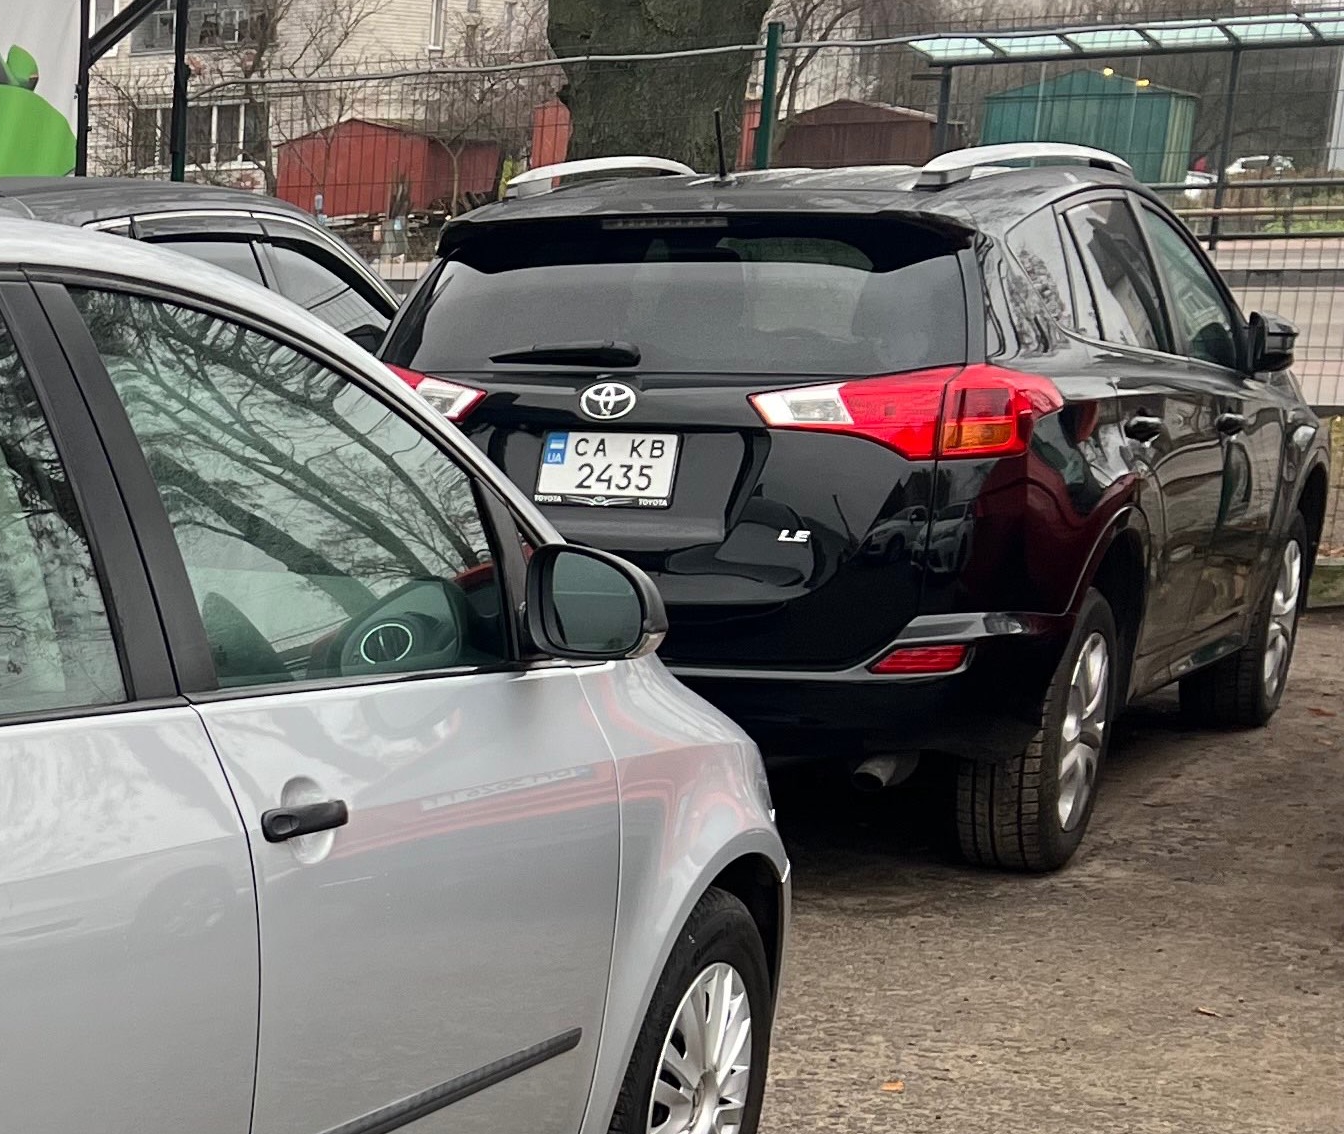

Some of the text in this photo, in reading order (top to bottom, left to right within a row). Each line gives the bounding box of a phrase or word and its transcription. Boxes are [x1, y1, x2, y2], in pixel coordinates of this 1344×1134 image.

[575, 438, 666, 459] CA KB
[547, 452, 563, 463] UA
[575, 463, 653, 491] 2435
[777, 529, 811, 542] LE
